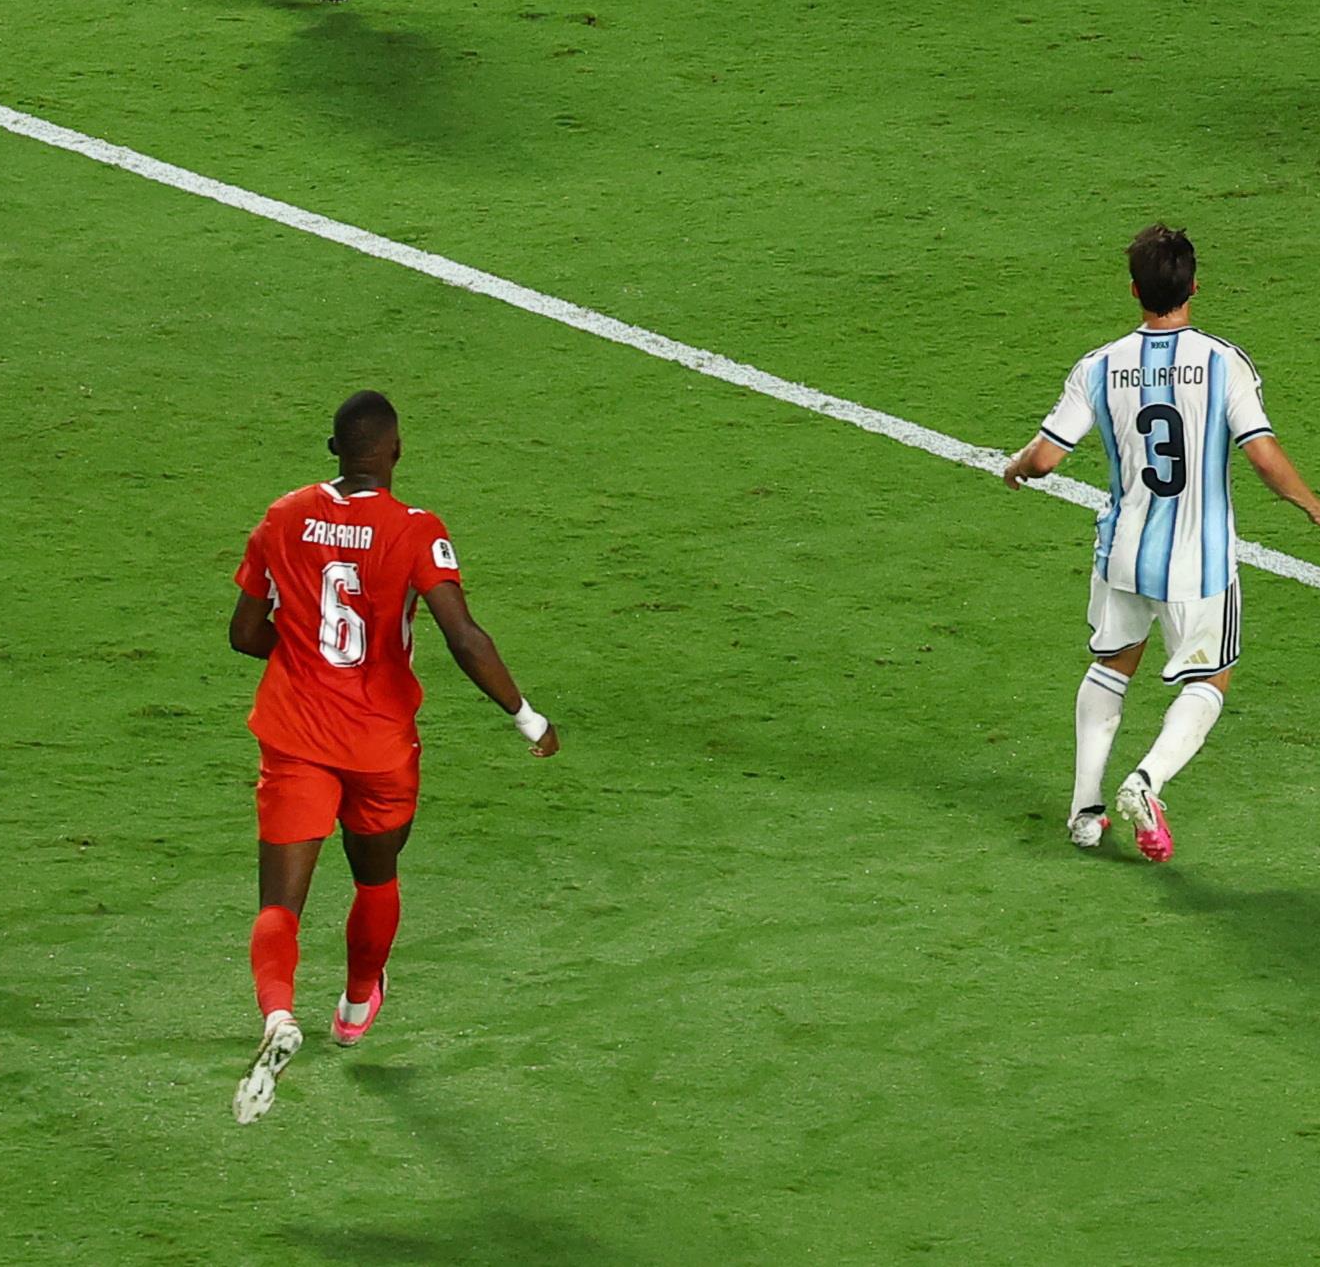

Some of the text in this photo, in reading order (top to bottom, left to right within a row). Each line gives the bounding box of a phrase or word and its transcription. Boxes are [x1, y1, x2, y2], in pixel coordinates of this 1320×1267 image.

[1111, 365, 1204, 390] TAGLIAFICO
[1136, 403, 1187, 498] 3
[302, 518, 374, 550] ZAKARIA
[319, 561, 366, 669] 6
